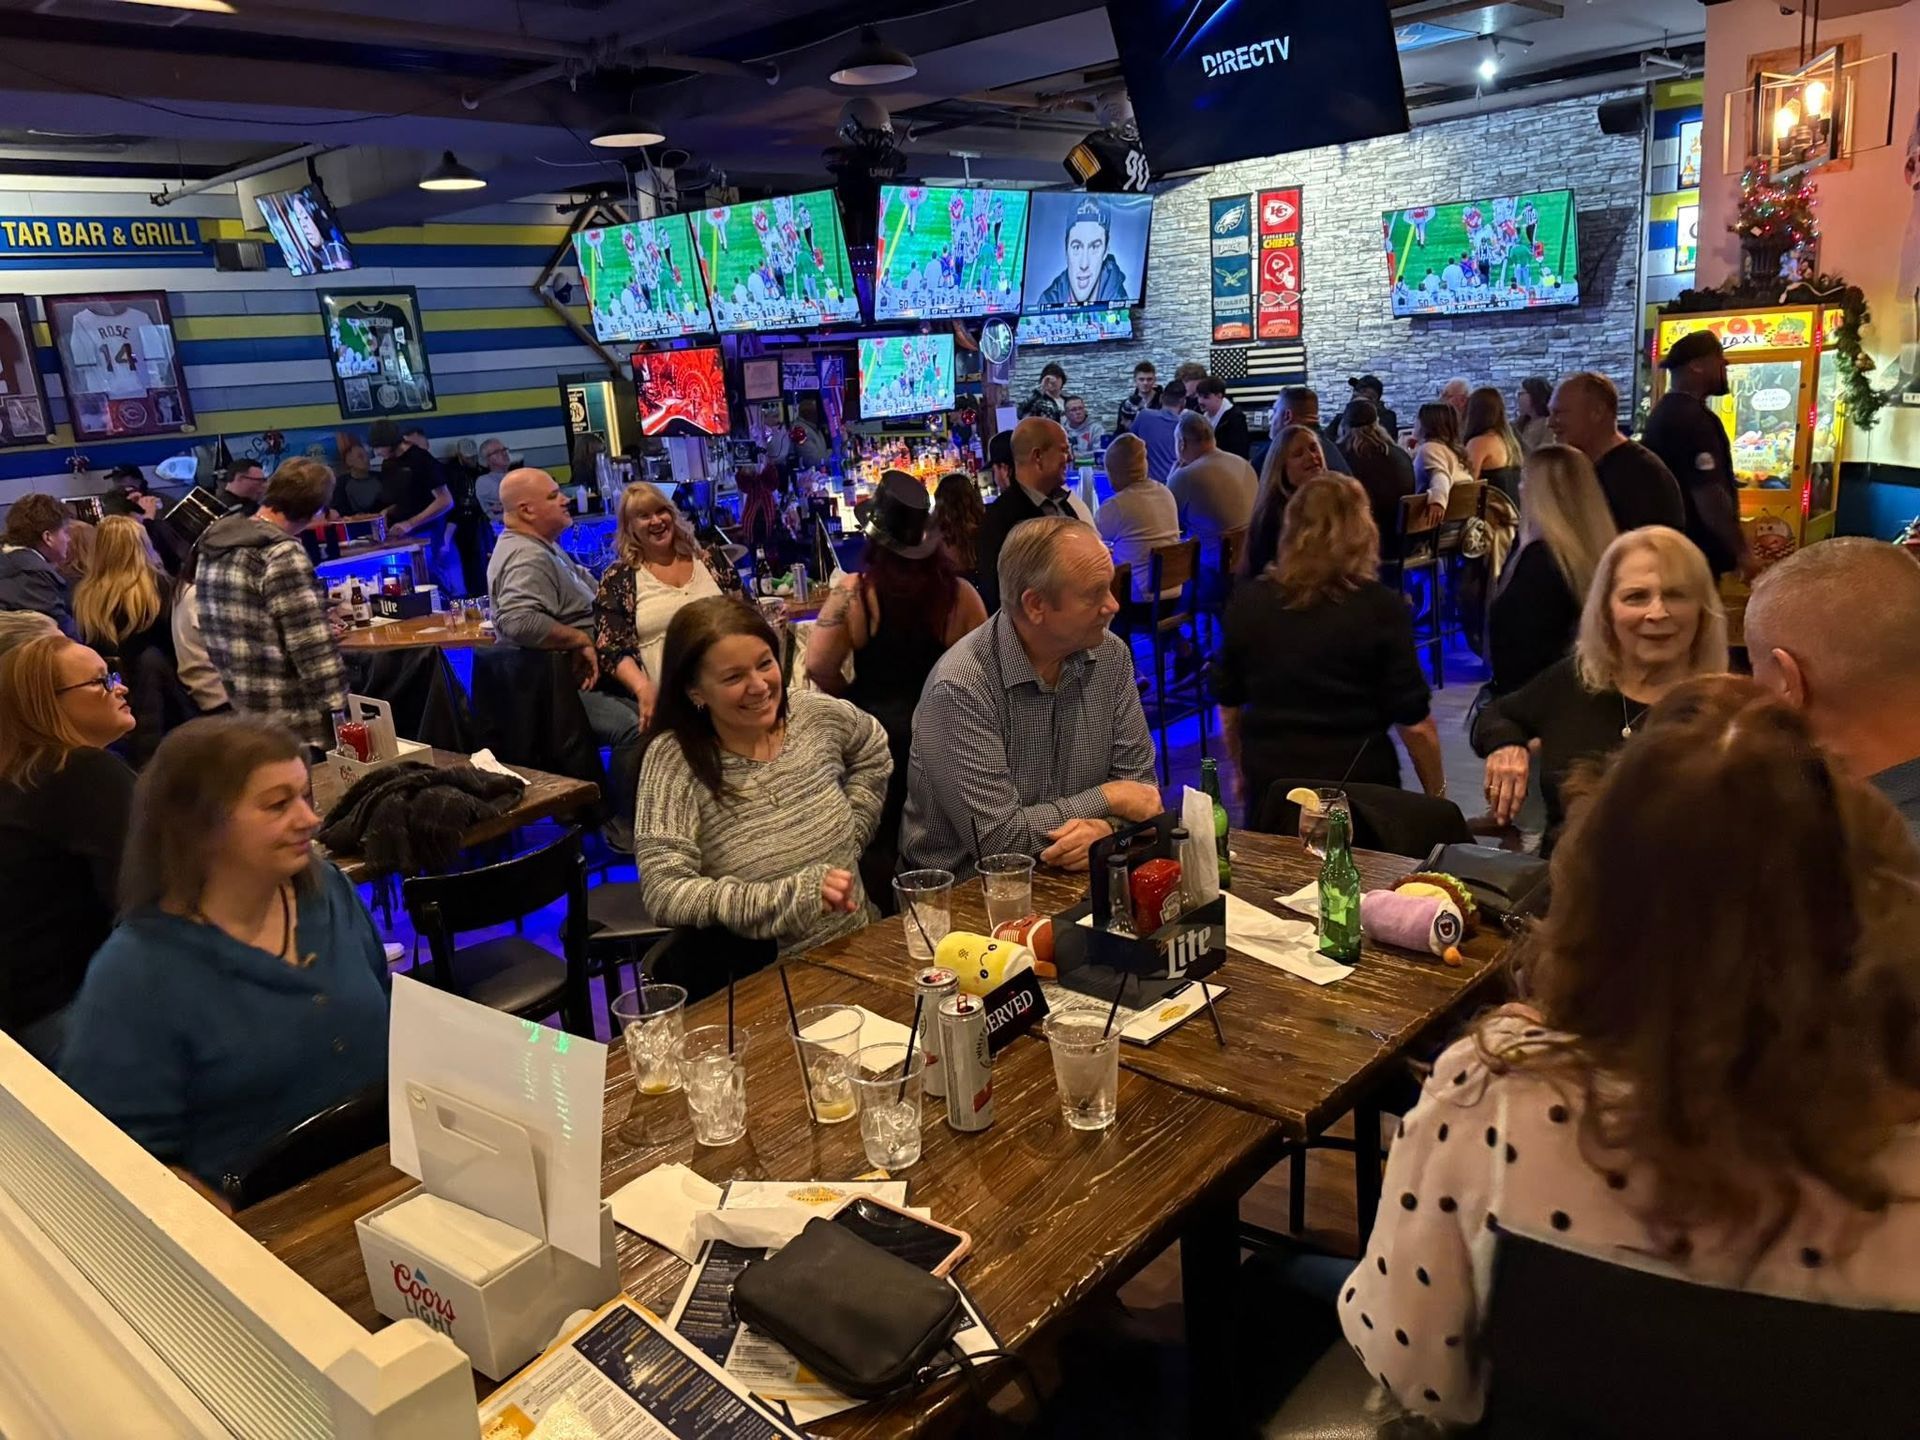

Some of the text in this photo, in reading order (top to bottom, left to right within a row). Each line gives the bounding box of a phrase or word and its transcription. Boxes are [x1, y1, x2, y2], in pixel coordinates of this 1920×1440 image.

[1201, 35, 1290, 78] DIRECTV
[1122, 149, 1150, 192] 90
[1, 221, 196, 246] TAR BAR & GRILL
[1263, 238, 1295, 249] CHIEFS
[98, 325, 131, 340] ROSE
[1708, 317, 1772, 340] TOY
[1722, 335, 1758, 346] TAXI
[99, 343, 138, 372] 14
[380, 600, 398, 615] Lite
[1166, 926, 1211, 980] Lite
[986, 989, 1034, 1034] ERVED
[390, 1260, 456, 1322] Coors
[404, 1295, 455, 1339] LIGHT
